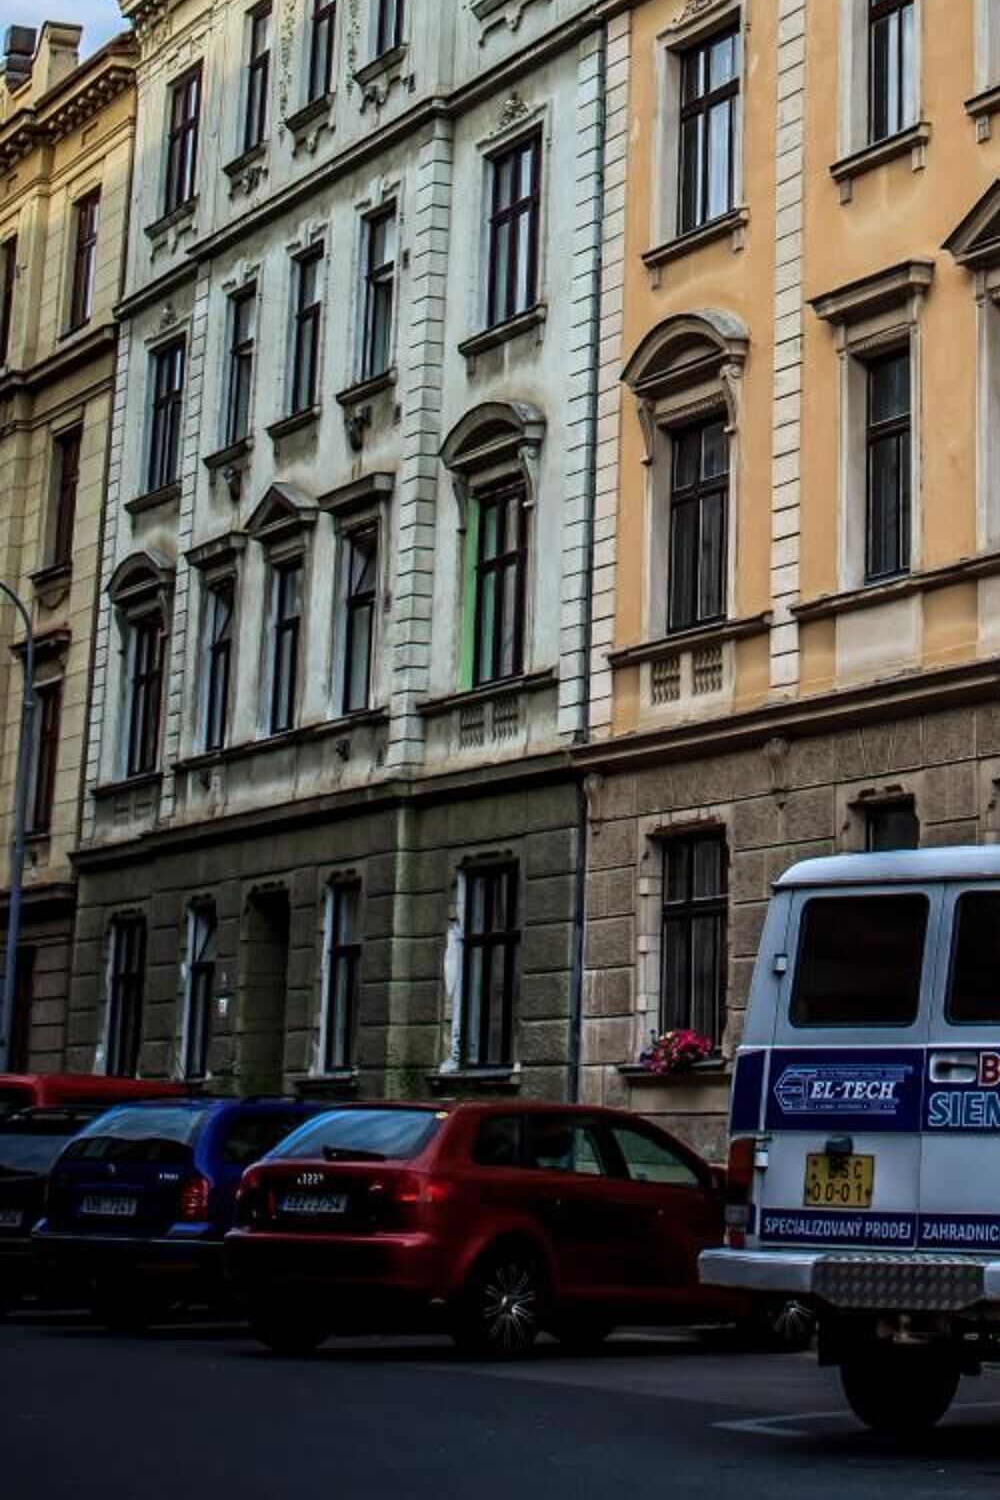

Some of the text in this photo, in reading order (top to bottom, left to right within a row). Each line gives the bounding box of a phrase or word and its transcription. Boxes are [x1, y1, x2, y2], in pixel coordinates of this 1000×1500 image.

[809, 1080, 897, 1100] EL-TECH
[763, 1215, 912, 1239] SPECIALIZOVANÝ PRODEJ
